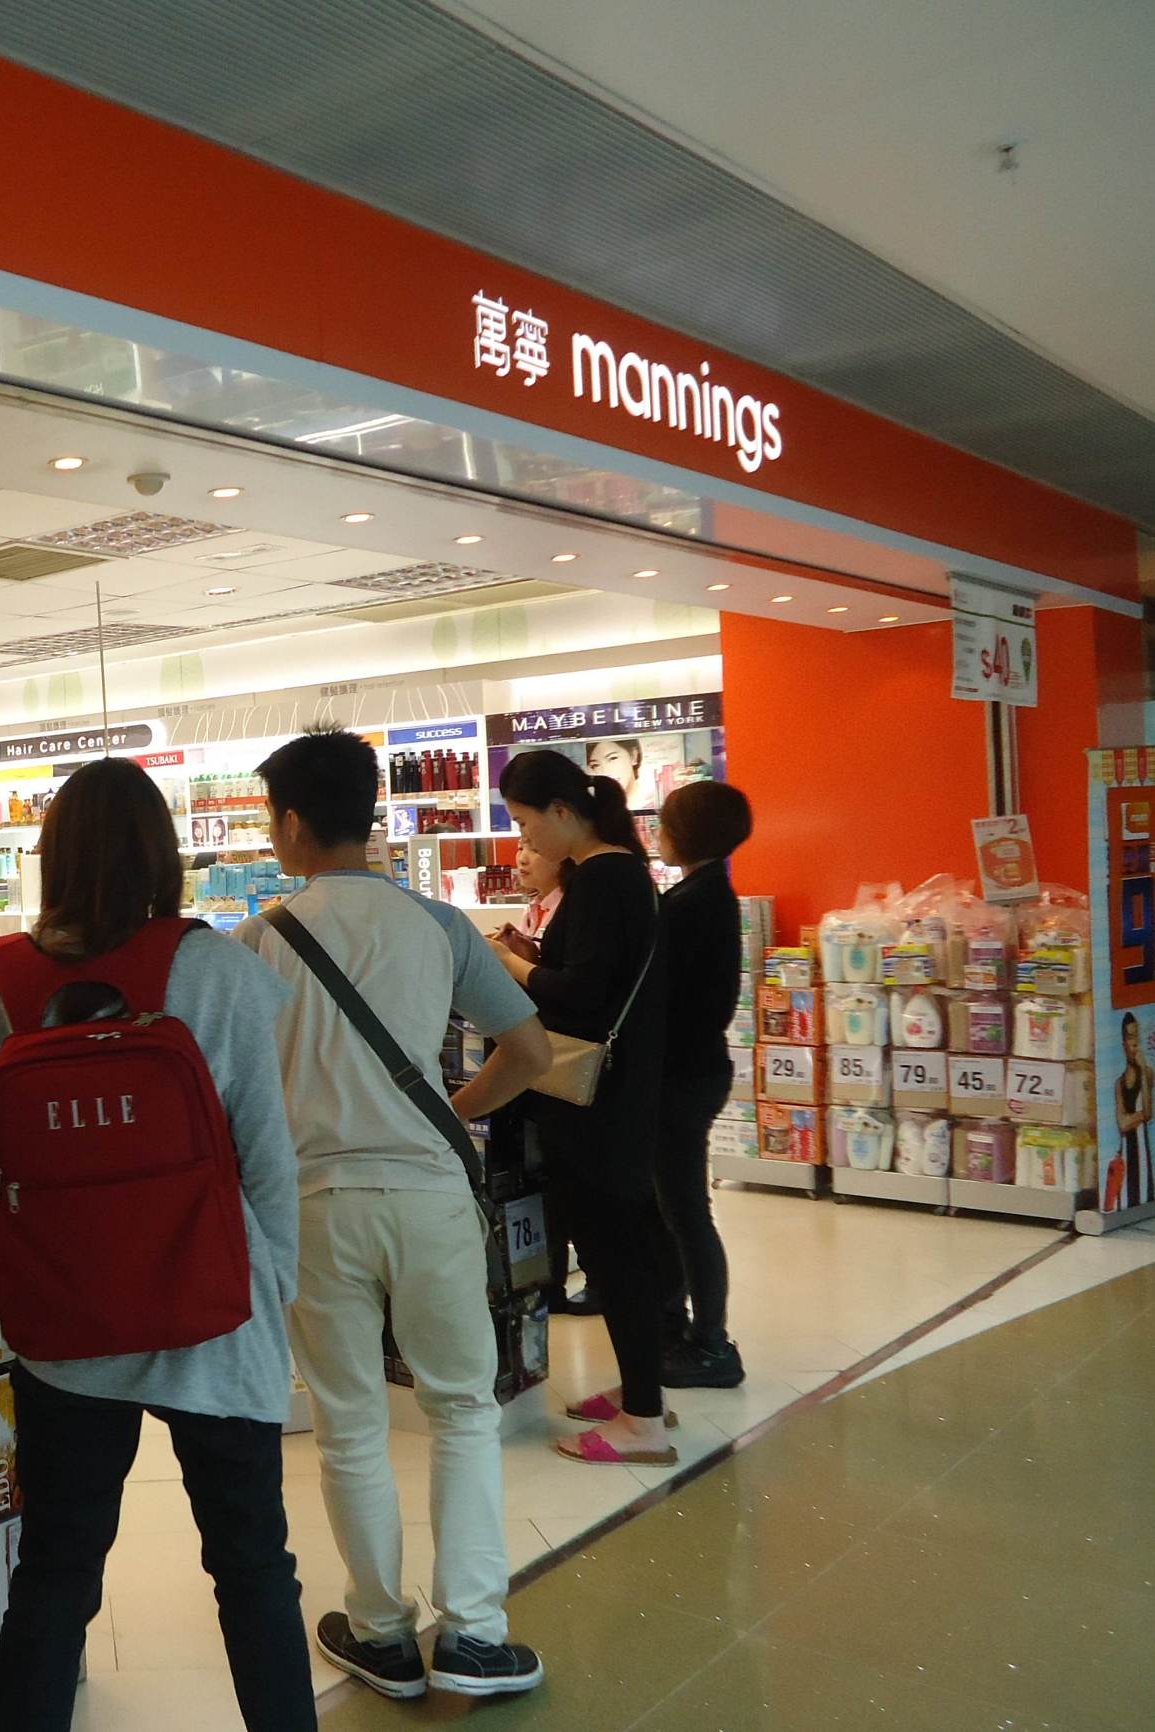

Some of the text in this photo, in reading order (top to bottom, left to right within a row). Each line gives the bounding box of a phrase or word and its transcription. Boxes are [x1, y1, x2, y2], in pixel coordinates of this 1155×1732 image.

[471, 289, 783, 473] 萬寧 mannings
[512, 700, 705, 732] MAYBELLINE
[633, 715, 705, 729] NEW YORK
[415, 727, 463, 739] success
[6, 743, 33, 757] Hair
[39, 739, 72, 754] Care
[146, 753, 179, 767] TSUBAKI
[47, 1094, 136, 1133] ELLE
